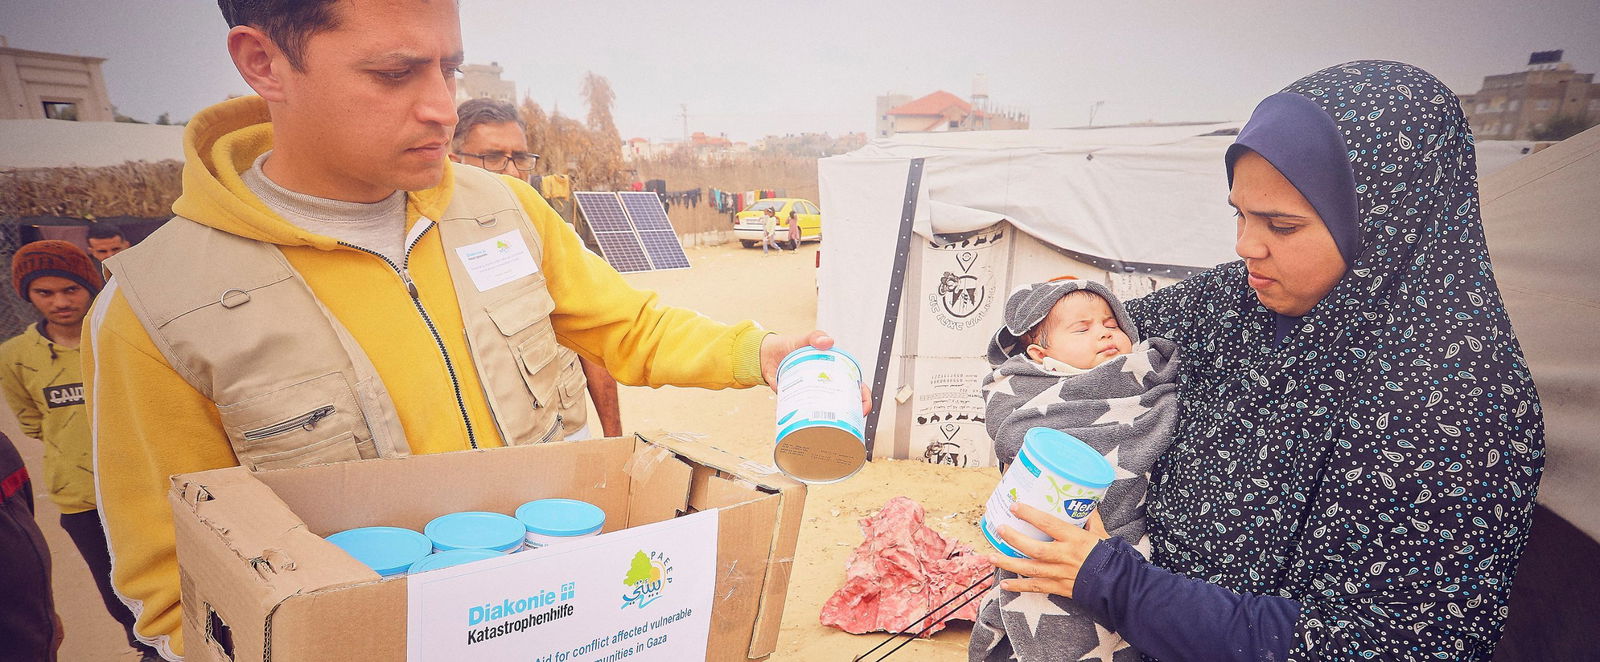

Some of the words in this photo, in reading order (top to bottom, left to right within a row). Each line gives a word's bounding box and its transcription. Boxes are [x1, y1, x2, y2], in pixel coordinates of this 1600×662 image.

[650, 551, 673, 584] PAEEP
[467, 604, 574, 645] Katastrophenhilfe
[468, 589, 556, 627] Diakonie
[555, 650, 571, 662] for
[572, 636, 610, 657] conflict
[611, 622, 649, 645] affected
[650, 608, 692, 630] vulnerable
[636, 642, 645, 654] in
[646, 634, 668, 649] Gaza
